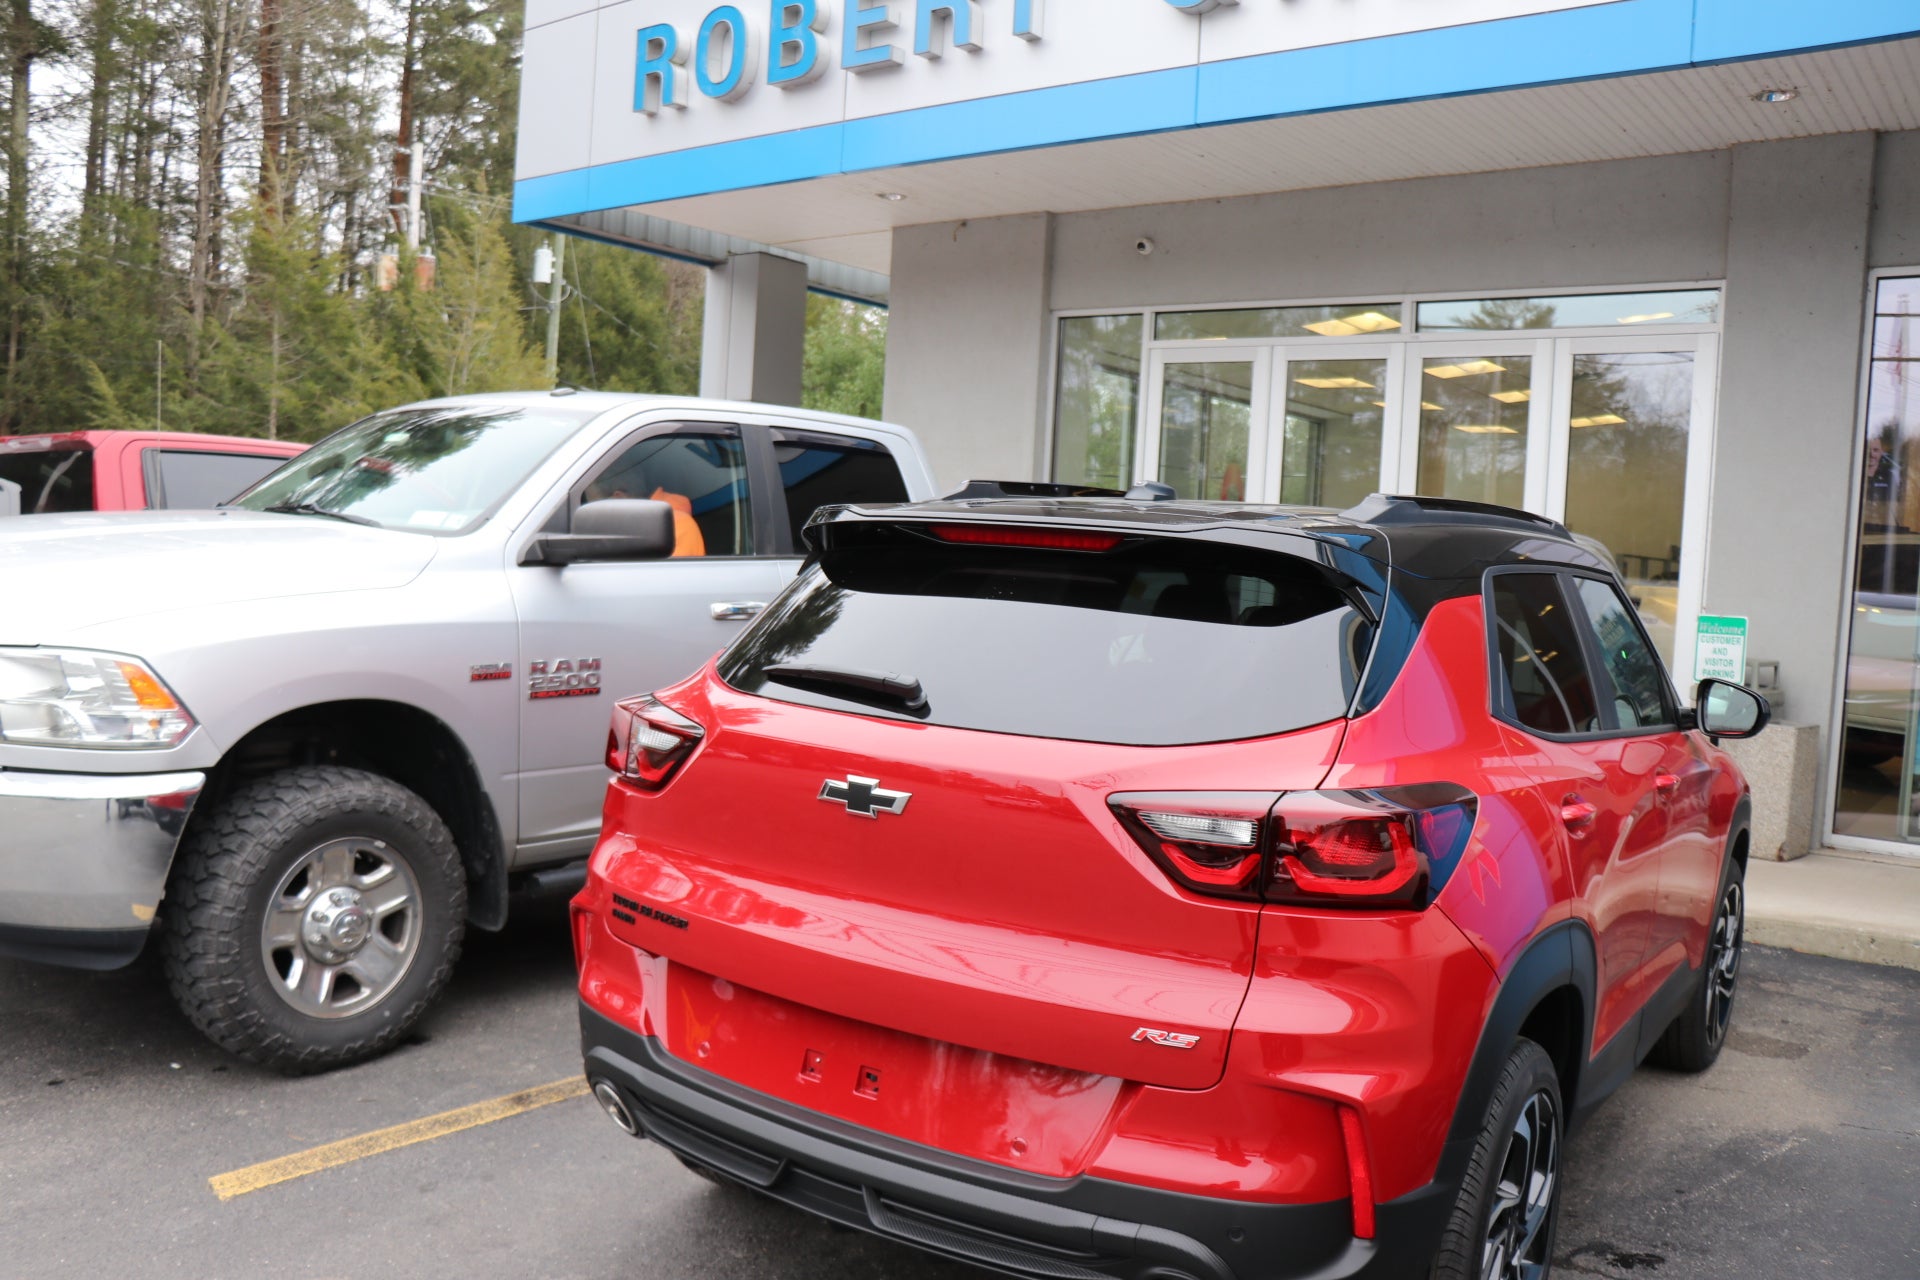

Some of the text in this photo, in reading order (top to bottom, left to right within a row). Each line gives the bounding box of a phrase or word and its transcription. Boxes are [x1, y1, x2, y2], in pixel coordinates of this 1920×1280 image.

[1701, 636, 1741, 645] CUSTOMER
[1712, 647, 1728, 656] AND
[530, 658, 601, 674] RAM
[1705, 658, 1734, 667] VISITOR
[1702, 669, 1735, 679] PARKING
[529, 672, 600, 689] 2500
[531, 688, 600, 699] HEAVY DUTY
[1130, 1027, 1200, 1049] RS
